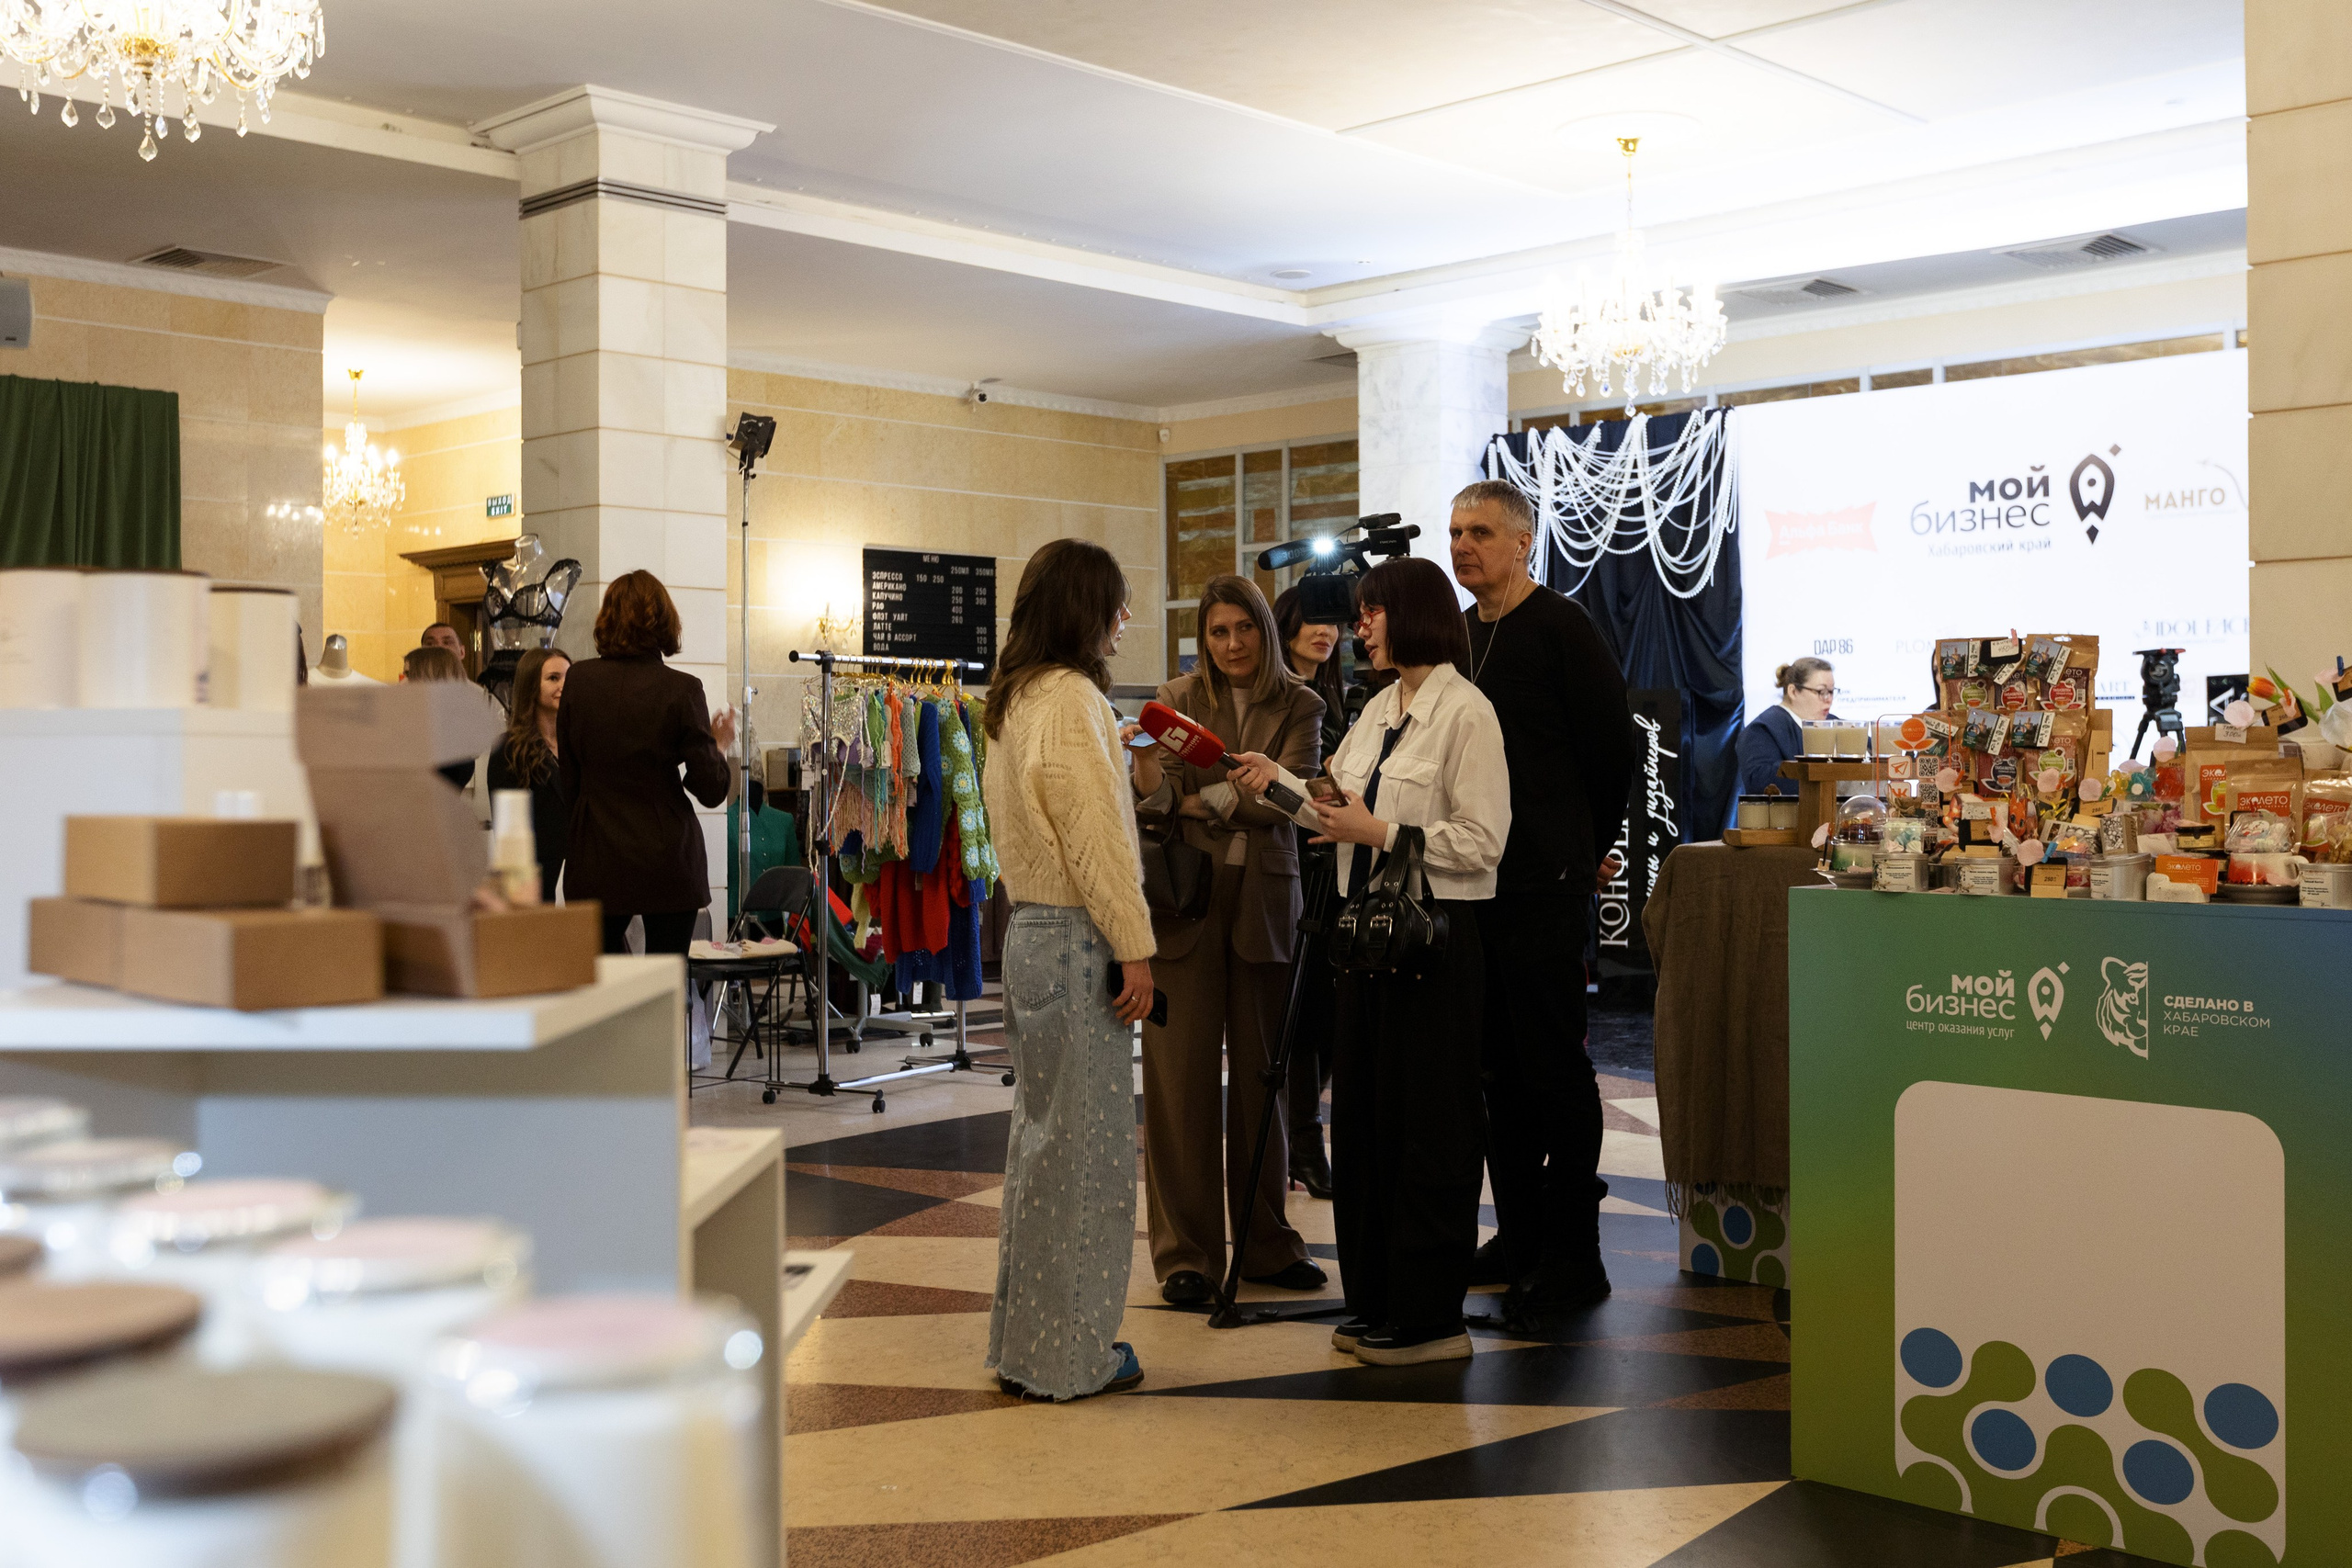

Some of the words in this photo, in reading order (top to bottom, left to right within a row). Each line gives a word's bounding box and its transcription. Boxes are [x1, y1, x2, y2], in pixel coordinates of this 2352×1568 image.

[1969, 464, 2050, 504] мой
[487, 495, 512, 508] ВЫХОД
[2144, 486, 2226, 512] МАНГО
[491, 505, 508, 516] EXIT
[1910, 497, 2051, 535] бизнес
[1928, 538, 2014, 558] Хабаровский
[2018, 536, 2052, 553] край
[872, 571, 903, 581] ЭСПРЕССО
[916, 574, 927, 583] 150
[933, 575, 944, 584] 250
[872, 581, 907, 592] АМЕРИКАНО
[952, 586, 963, 595] 200
[975, 587, 987, 596] 250
[872, 592, 903, 602] КАПУЧИНО
[952, 596, 963, 604] 250
[975, 597, 987, 606] 300
[872, 602, 885, 611] РАФ
[952, 606, 963, 615] 400
[872, 612, 888, 621] ФЛЭТ
[873, 622, 892, 631] ЛАТТЕ
[976, 626, 987, 636] 300
[887, 633, 892, 642] В
[894, 634, 917, 643] АССОРТ
[977, 637, 988, 645] 120
[873, 642, 889, 651] ВОДА
[977, 646, 988, 655] 120
[1633, 713, 1679, 838] дизайнеров
[1647, 830, 1660, 847] и
[1951, 969, 2015, 998] мой
[1905, 984, 2017, 1021] бизнес
[2163, 995, 2239, 1011] СДЕЛАНО
[2243, 1000, 2255, 1012] В
[2163, 1011, 2271, 1029] ХАБАРОВСКОМ
[1905, 1018, 1935, 1033] центр
[1938, 1021, 1985, 1037] оказания
[1986, 1027, 2016, 1041] услуг
[2163, 1024, 2199, 1037] КРАЕ
